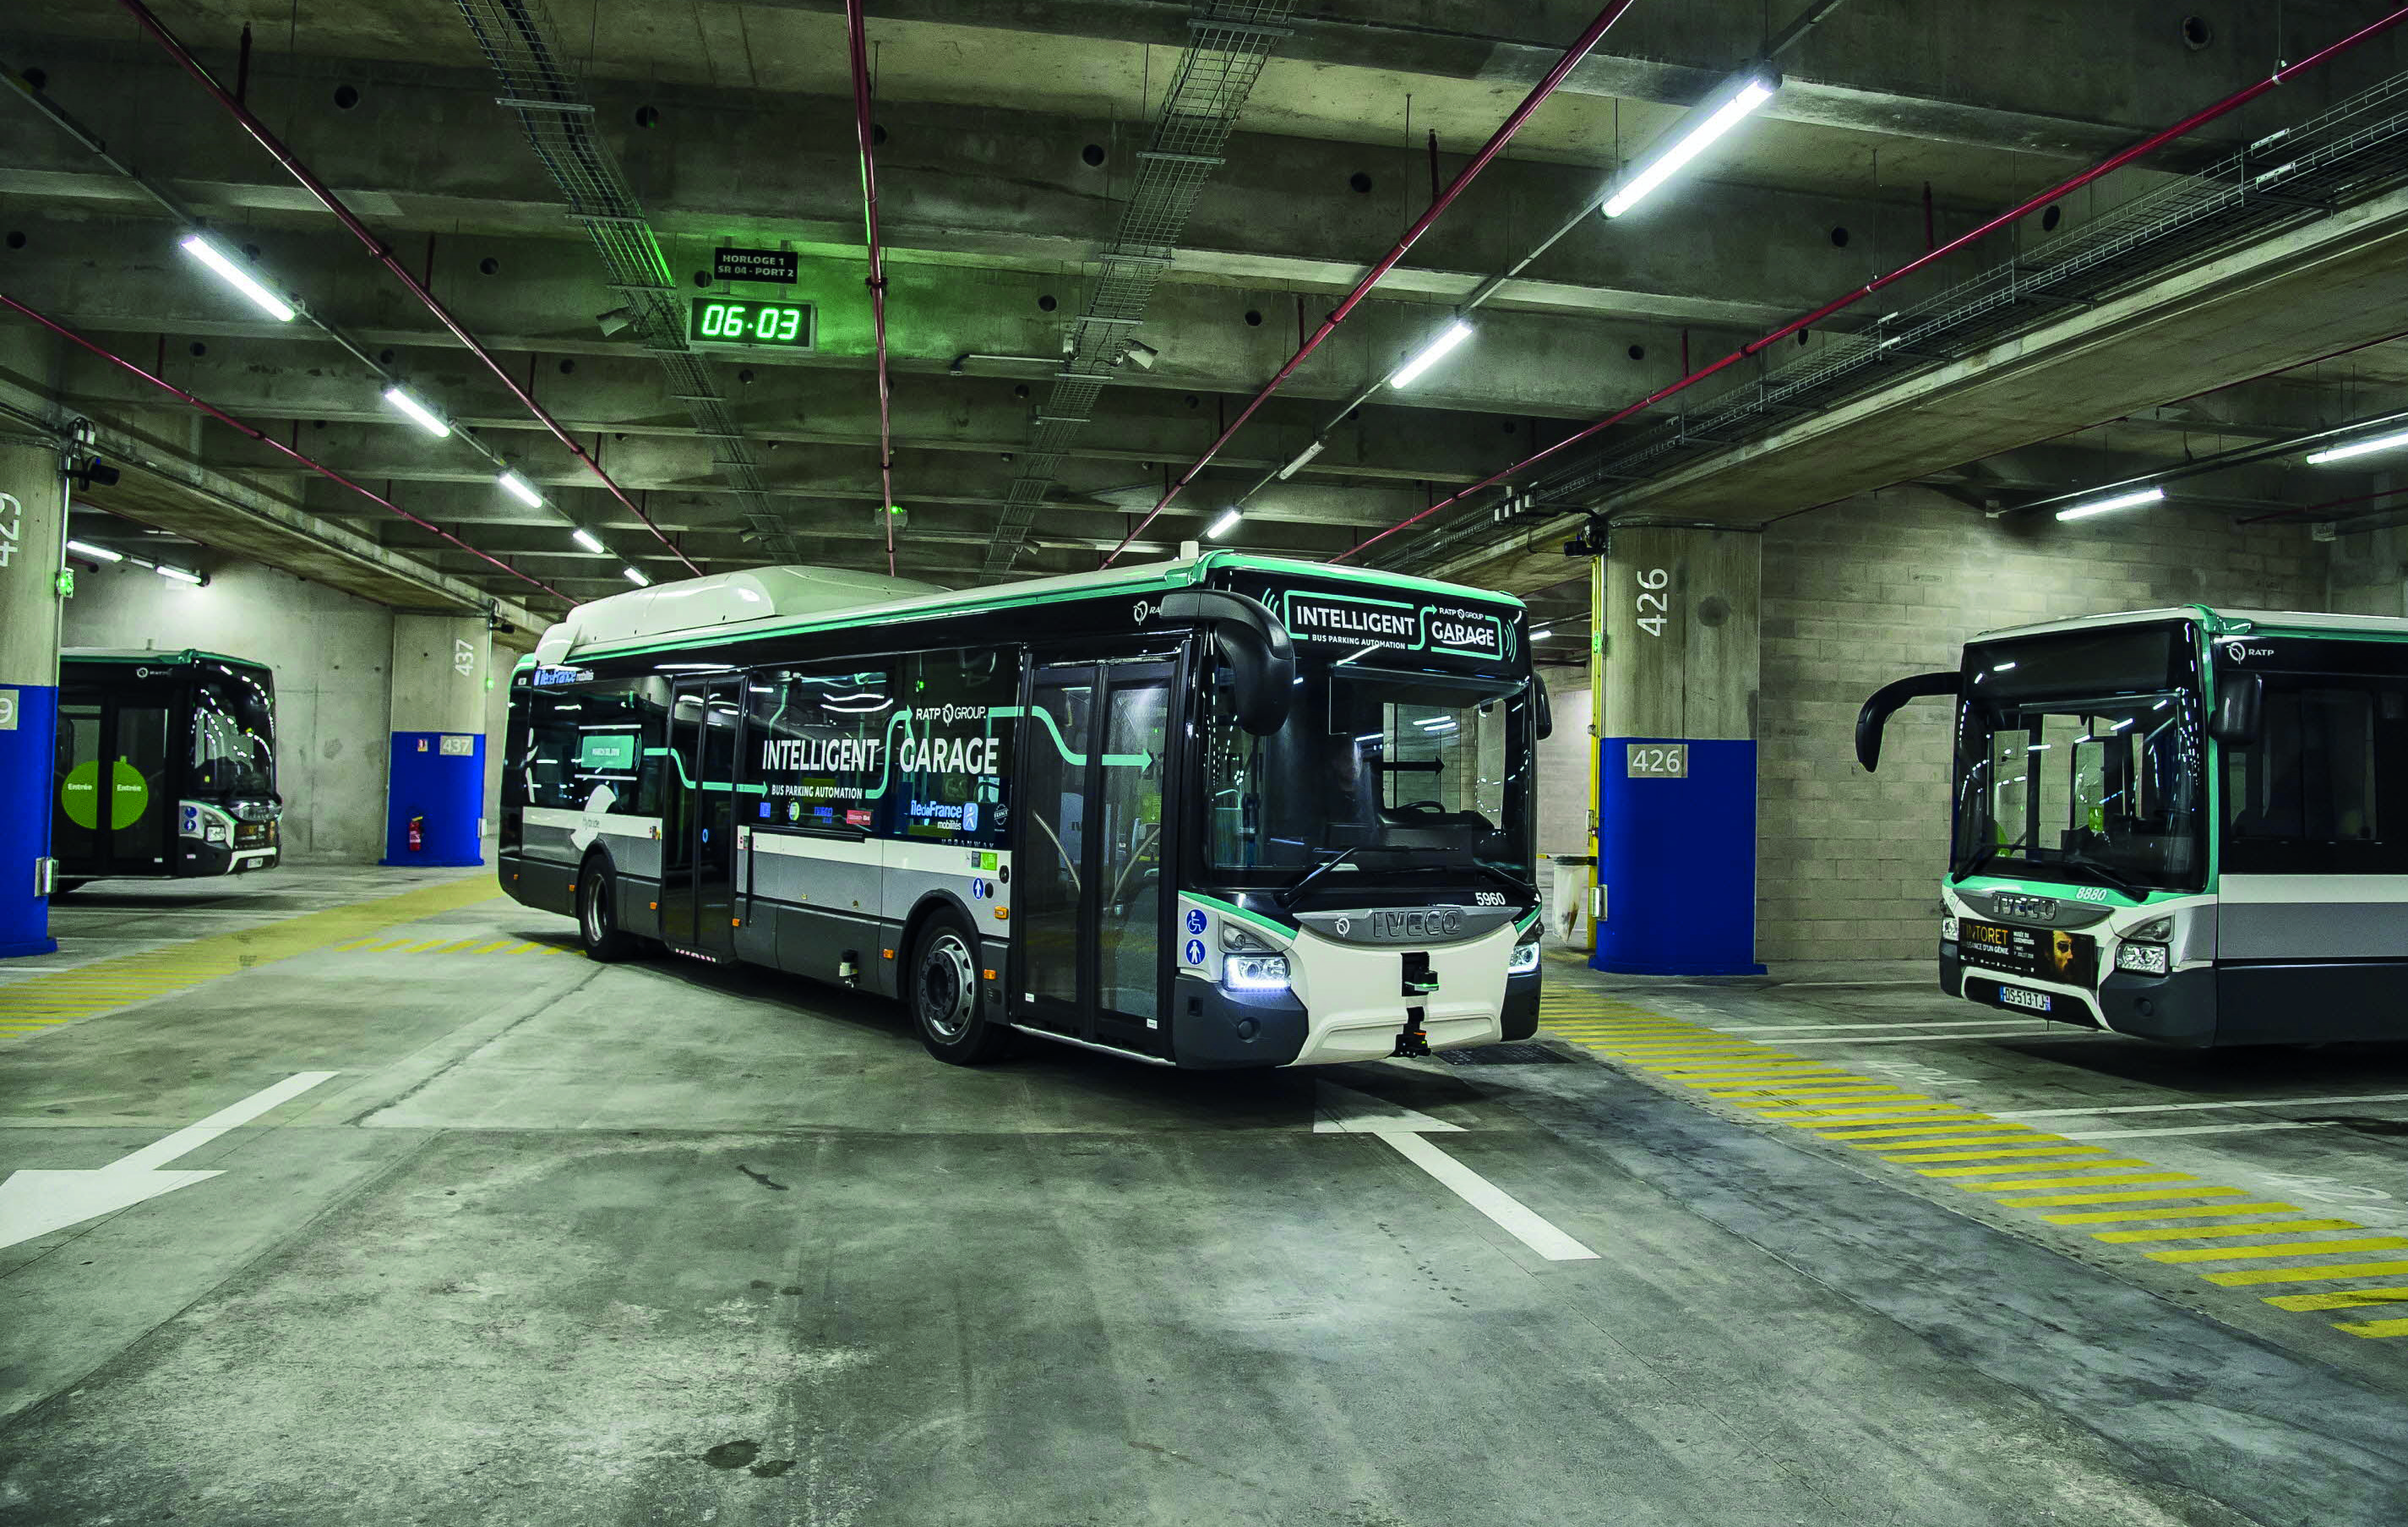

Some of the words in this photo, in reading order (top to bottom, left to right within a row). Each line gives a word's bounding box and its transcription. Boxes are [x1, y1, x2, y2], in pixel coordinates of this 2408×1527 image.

[722, 254, 776, 265] HORLOGE
[718, 265, 732, 274] SR
[755, 266, 785, 276] PORT
[787, 269, 794, 277] 2
[1149, 606, 1161, 614] RA
[1636, 568, 1668, 637] 426
[1296, 605, 1415, 635] INTELLIGENT
[1439, 607, 1457, 616] RATP
[1464, 611, 1484, 620] GROUP
[1431, 620, 1495, 647] GARAGE
[1311, 634, 1327, 643] BUS
[1328, 635, 1360, 646] PARKING
[1360, 638, 1406, 650] AUTOMATION
[455, 639, 474, 677] 437
[2247, 648, 2275, 657] RATP
[916, 707, 941, 720] RATP
[442, 738, 471, 754] 437
[762, 739, 880, 772] INTELLIGENT
[899, 738, 1000, 774] GARAGE
[1632, 749, 1681, 772] 426
[771, 784, 784, 795] BUS
[785, 784, 814, 798] PARKING
[814, 787, 863, 799] AUTOMATION
[1474, 892, 1506, 906] 5960
[2076, 886, 2107, 902] 8880
[1373, 909, 1461, 938] IVECO
